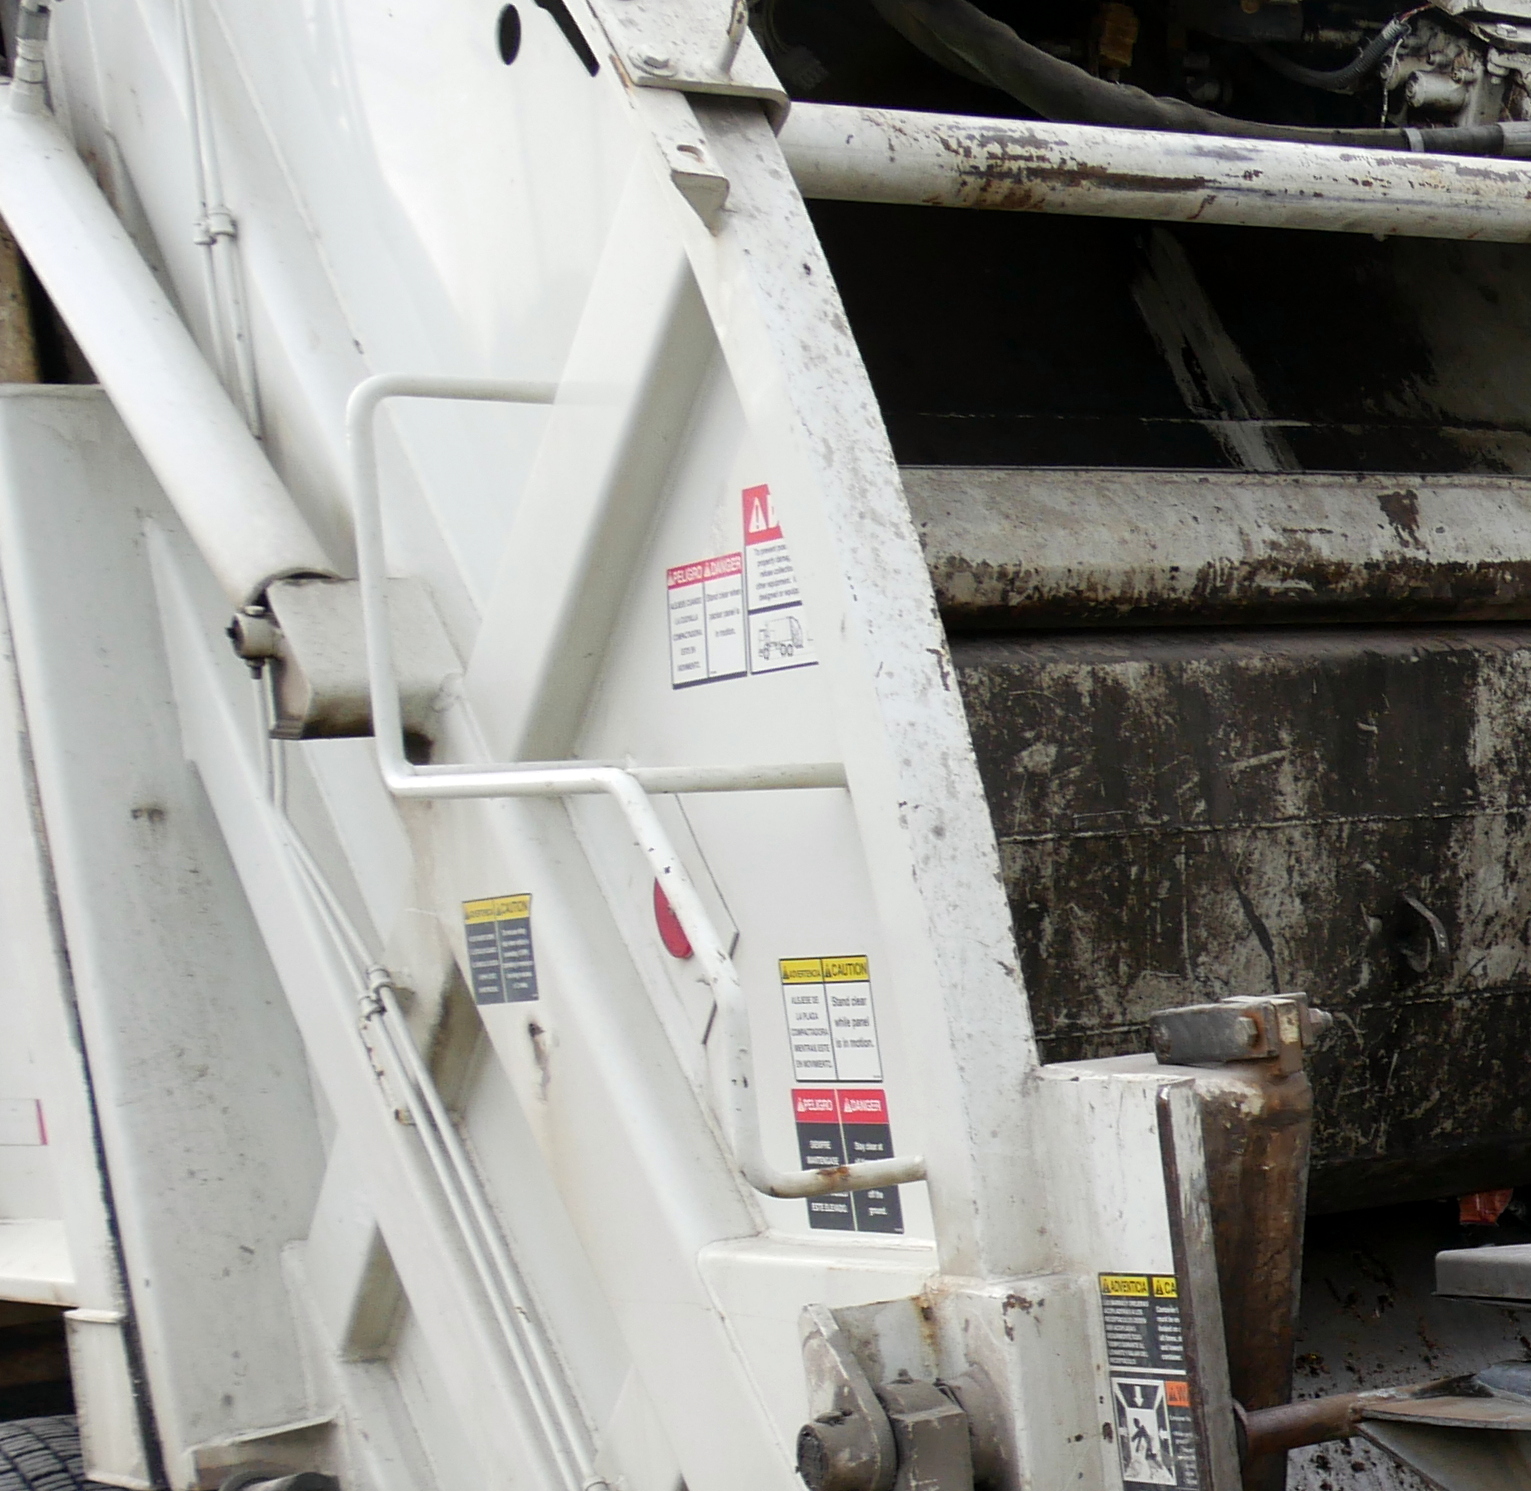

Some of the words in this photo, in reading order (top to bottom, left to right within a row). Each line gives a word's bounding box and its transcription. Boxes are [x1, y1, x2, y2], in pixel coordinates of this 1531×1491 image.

[710, 555, 742, 576] DANGER
[673, 565, 703, 584] PELIGRO
[831, 962, 868, 977] CAUTION
[831, 996, 850, 1007] Stand
[851, 996, 867, 1006] clear
[834, 1016, 851, 1028] while
[852, 1016, 870, 1030] panel
[803, 1098, 834, 1111] PELIGRO
[850, 1099, 882, 1112] DANGER
